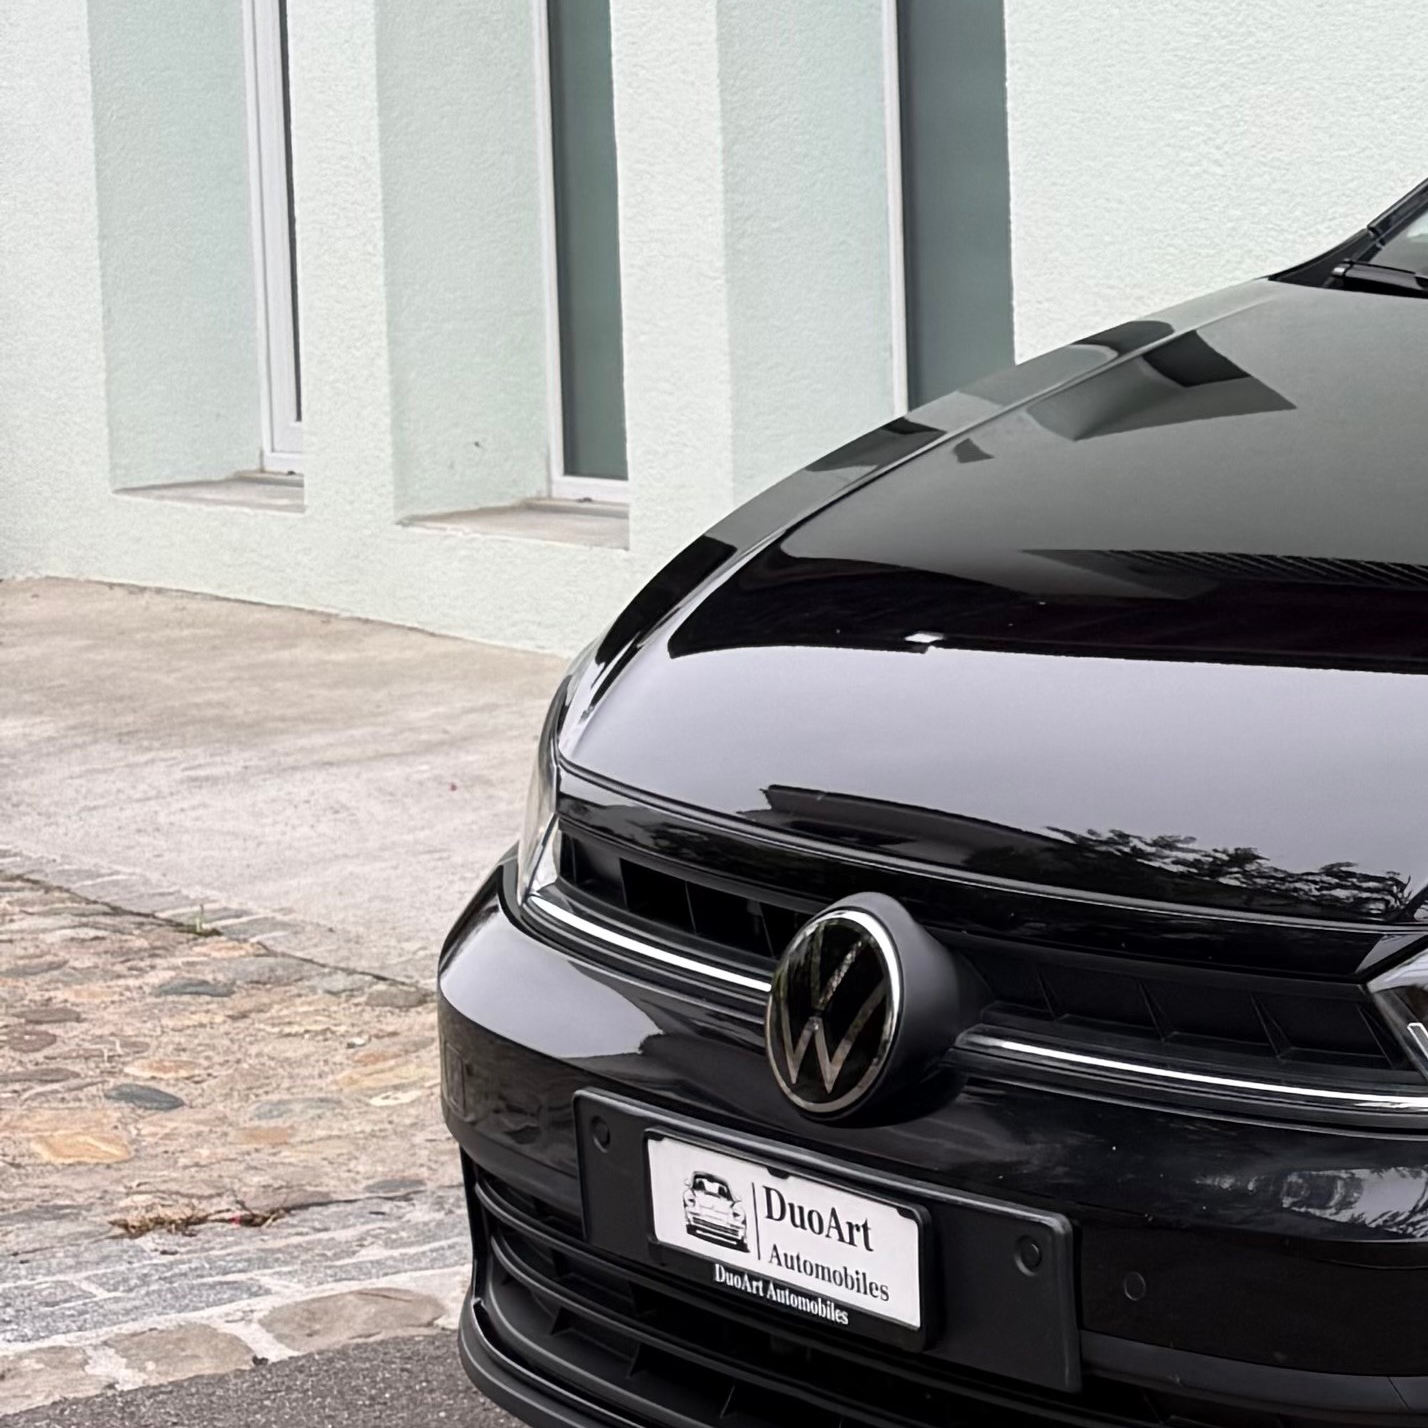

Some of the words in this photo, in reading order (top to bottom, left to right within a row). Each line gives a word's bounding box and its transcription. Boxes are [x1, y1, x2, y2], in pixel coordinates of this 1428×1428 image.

[762, 1185, 874, 1252] DuoArt
[714, 1263, 765, 1297] DuoArt
[765, 1281, 849, 1325] Automobiles
[768, 1243, 890, 1302] Automobiles
